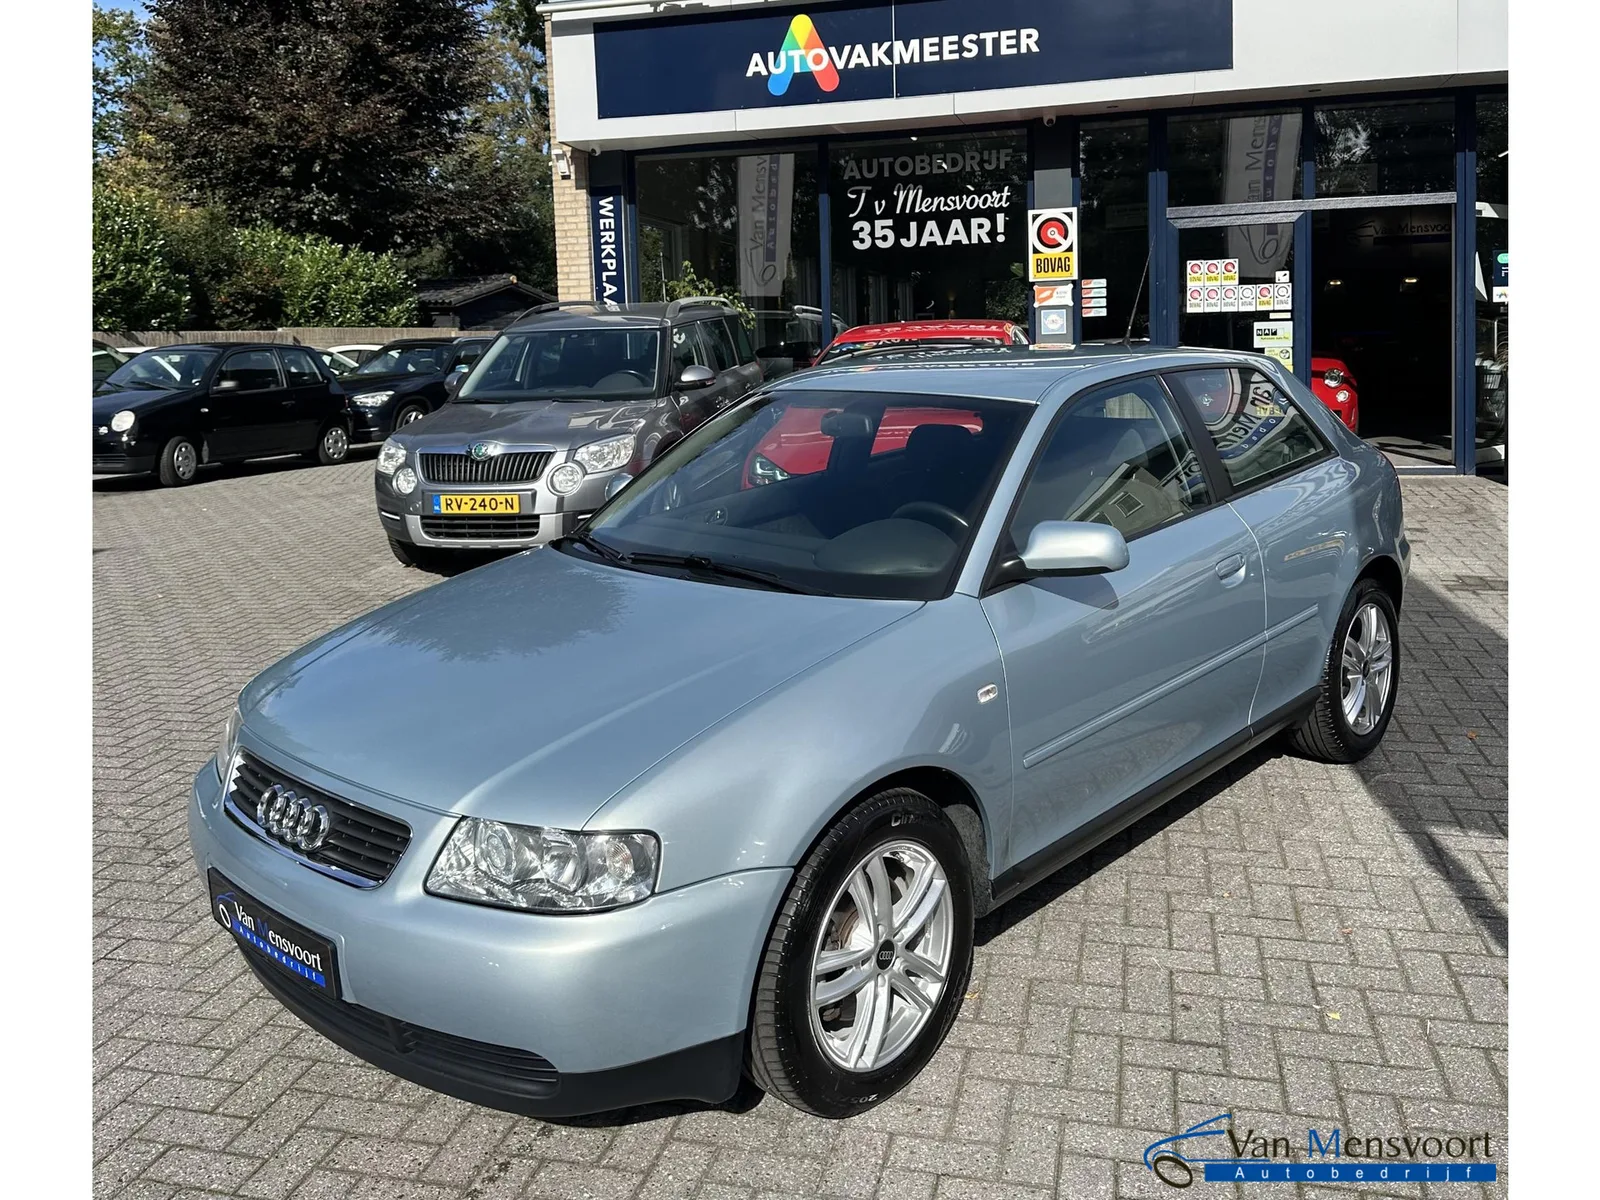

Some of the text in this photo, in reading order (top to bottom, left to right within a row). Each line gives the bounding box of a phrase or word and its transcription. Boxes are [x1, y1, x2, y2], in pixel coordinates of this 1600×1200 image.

[746, 27, 1040, 78] AUTOVAKMEESTER
[843, 149, 1013, 180] AUTOBEDRIJF
[847, 183, 1011, 217] T v Mensvoort
[852, 213, 1006, 251] 35 JAAR!
[1036, 256, 1071, 273] BOVAG
[444, 496, 514, 511] RV-240-N
[234, 901, 322, 971] Van Mensvoort
[239, 926, 316, 980] Autobedrijf
